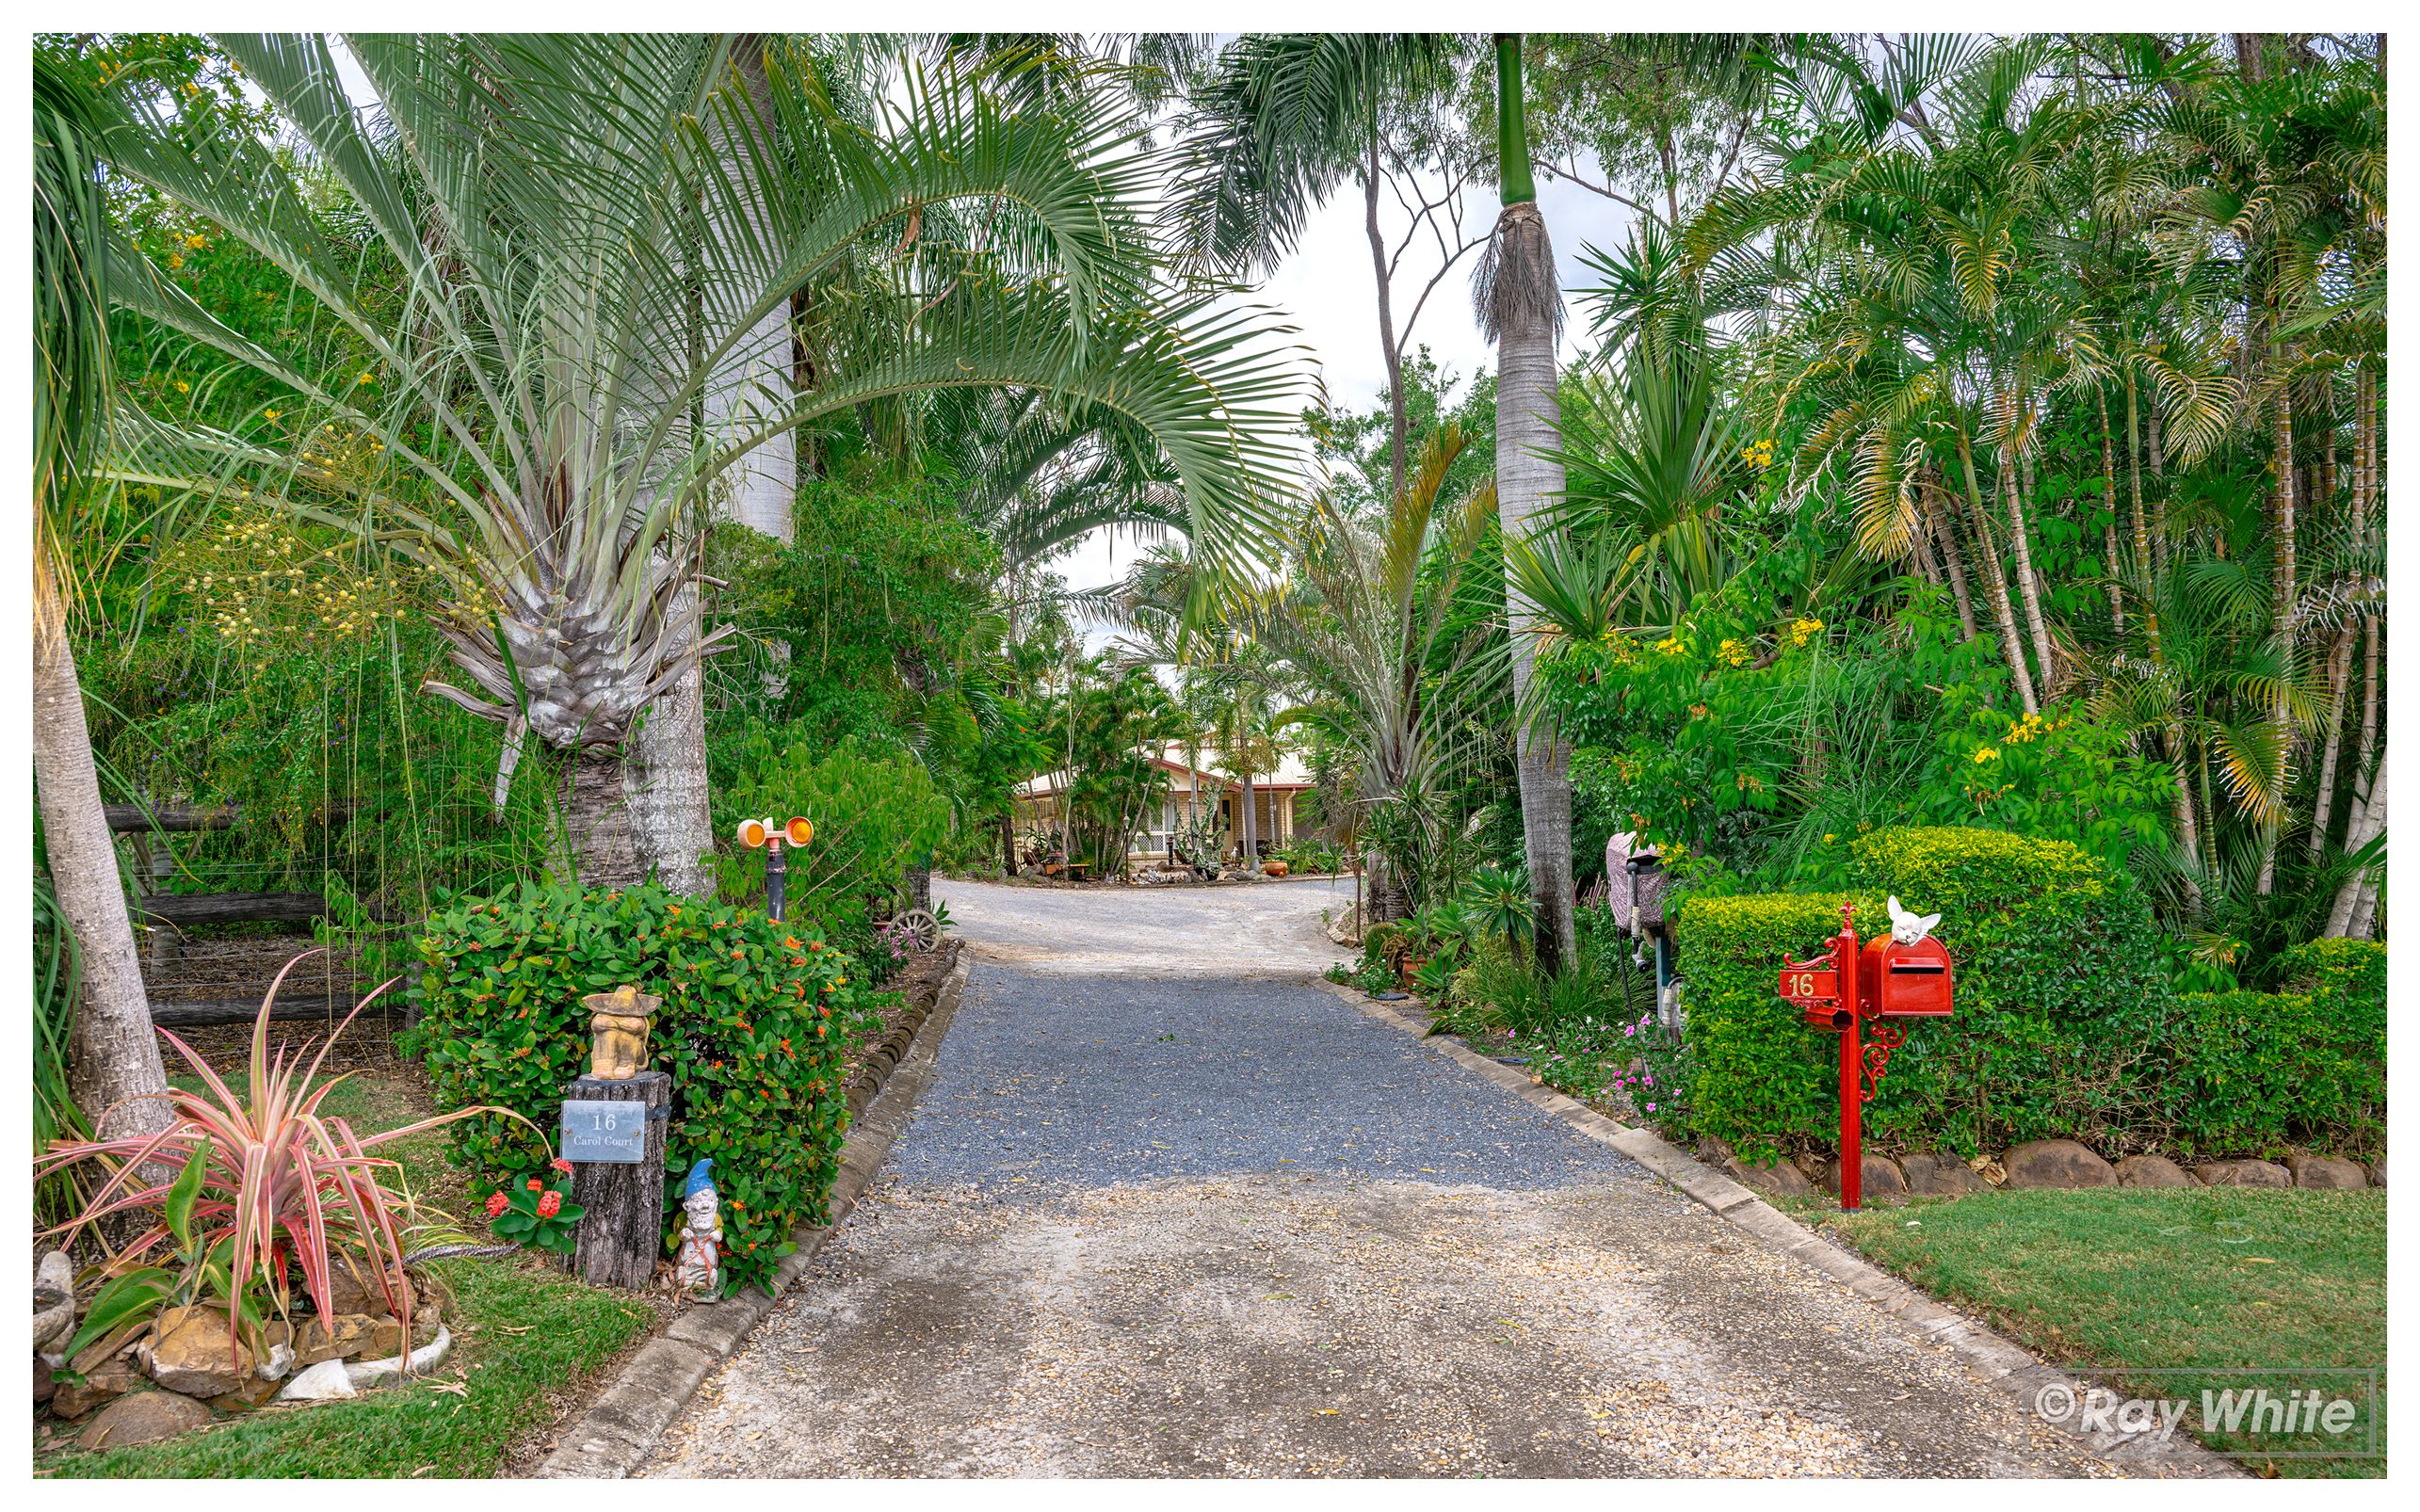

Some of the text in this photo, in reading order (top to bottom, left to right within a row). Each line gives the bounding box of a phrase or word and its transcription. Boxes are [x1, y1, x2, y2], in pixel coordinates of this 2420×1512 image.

[1789, 973, 1814, 997] 16
[592, 1114, 616, 1131] 16
[573, 1135, 633, 1146] Carol Court
